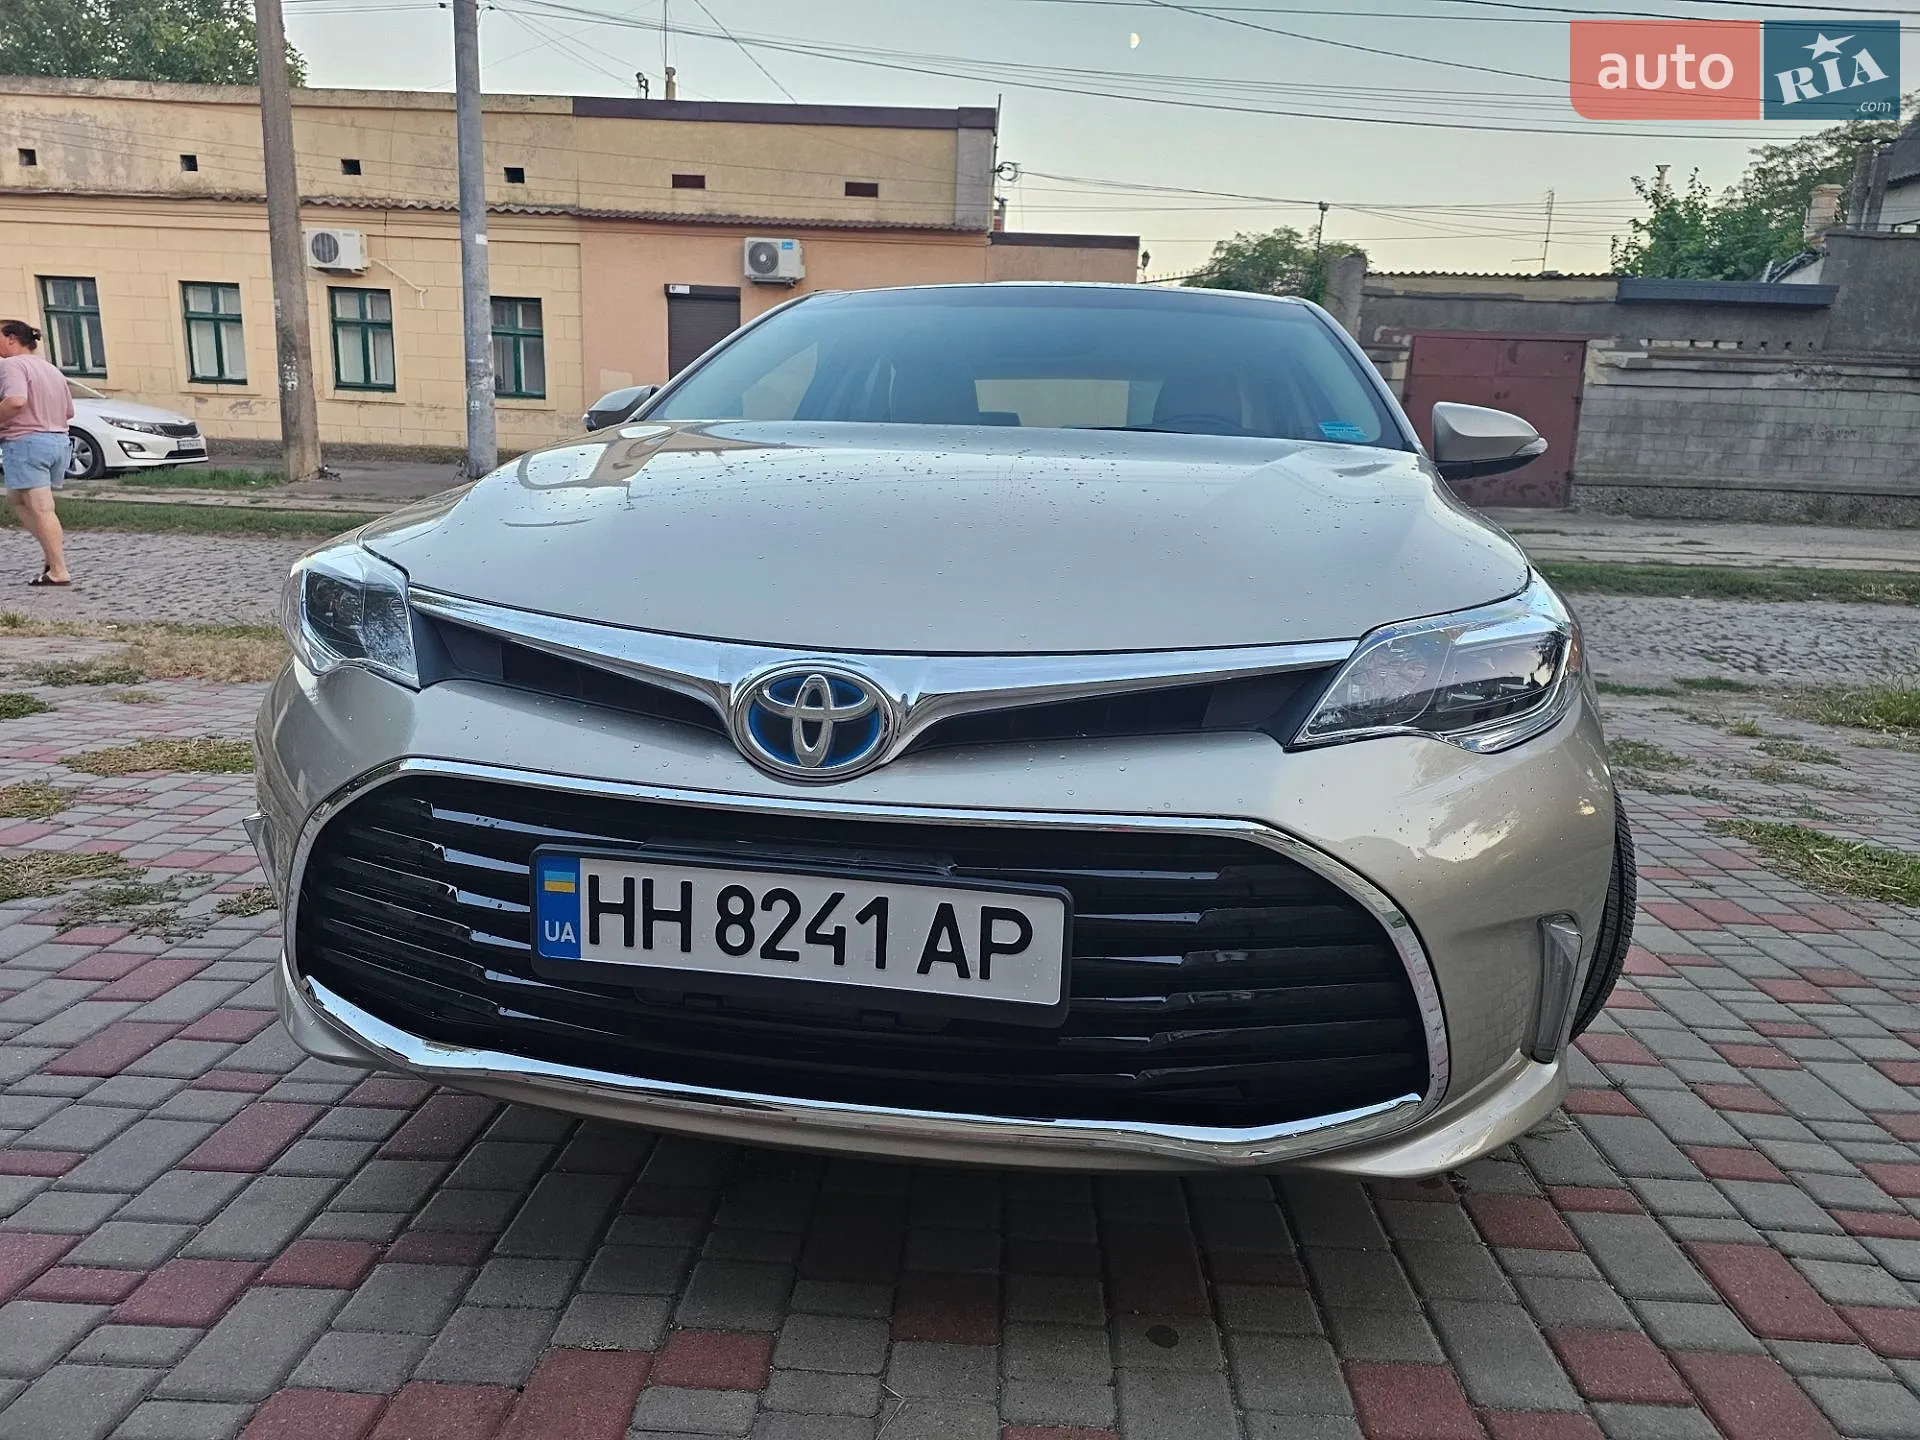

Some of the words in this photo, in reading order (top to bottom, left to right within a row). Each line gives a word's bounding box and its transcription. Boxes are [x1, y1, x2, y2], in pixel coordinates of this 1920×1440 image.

[544, 920, 576, 944] UA
[587, 874, 693, 953] HH
[714, 884, 890, 970] 8241
[916, 902, 1034, 980] AP
